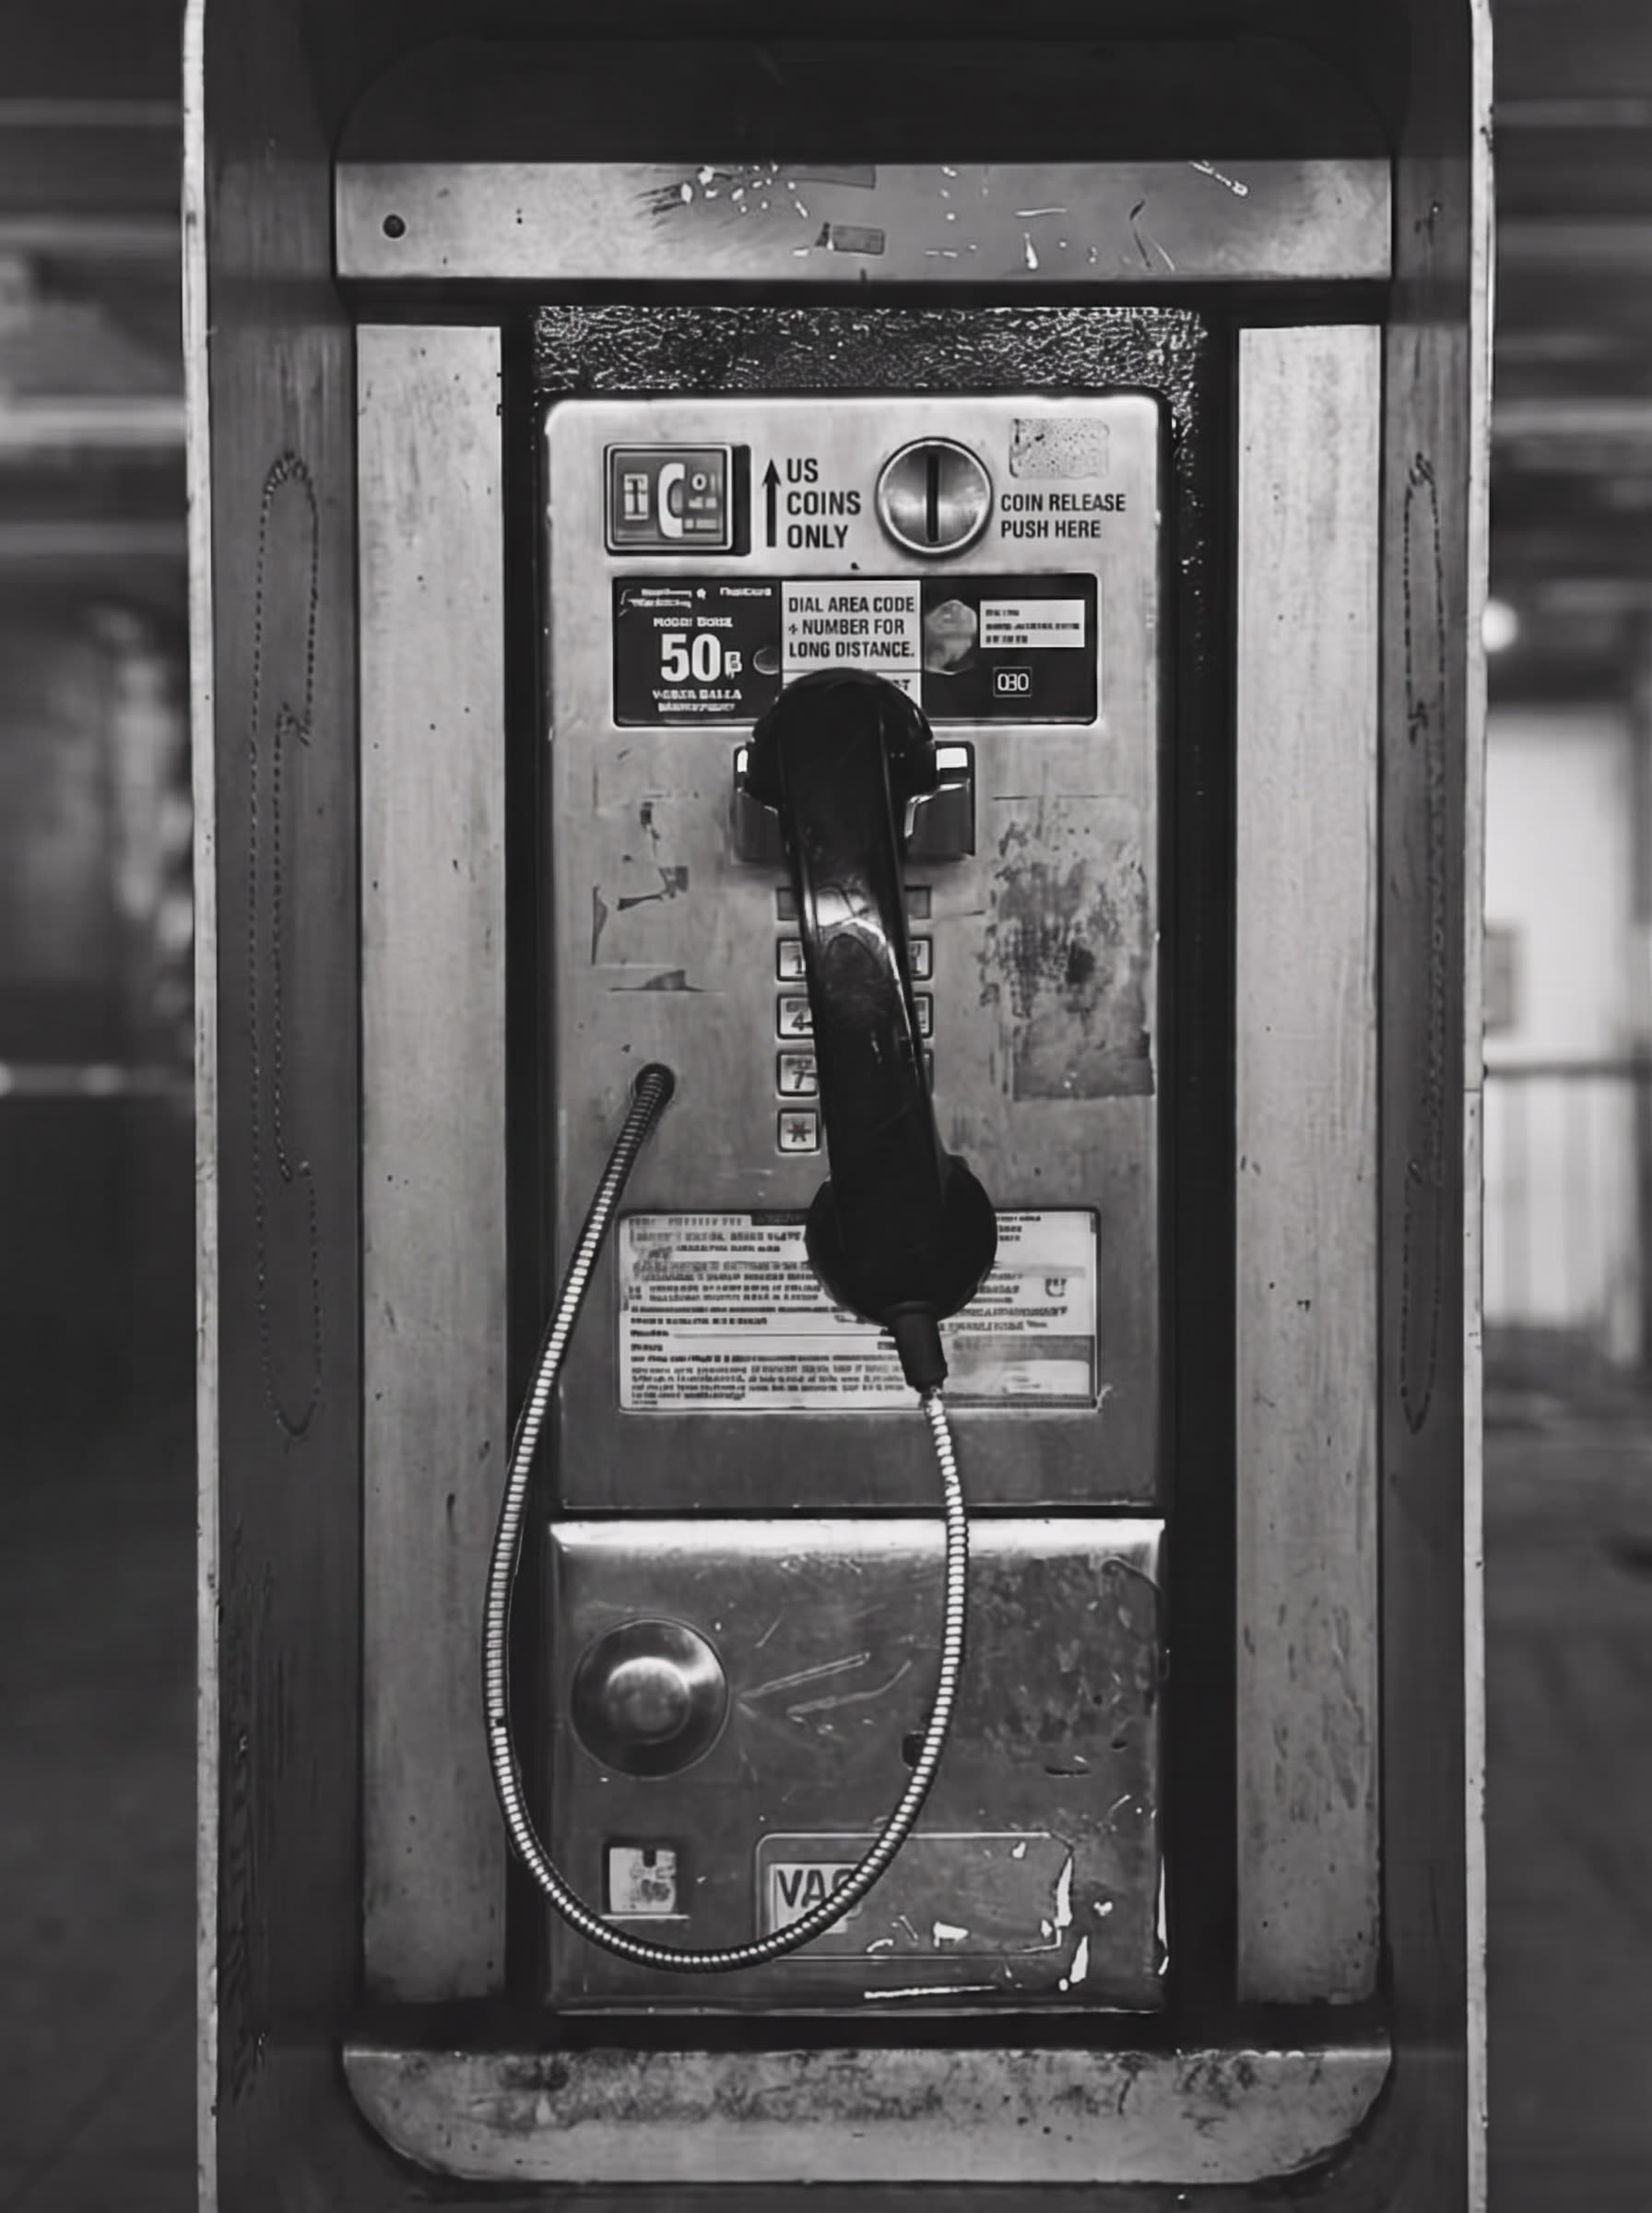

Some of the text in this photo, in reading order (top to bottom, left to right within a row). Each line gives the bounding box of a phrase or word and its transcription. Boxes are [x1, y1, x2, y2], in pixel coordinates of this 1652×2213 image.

[786, 457, 819, 484] US
[786, 490, 862, 516] COINS
[1000, 492, 1127, 513] COIN RELEASE
[786, 524, 849, 550] ONLY
[1000, 519, 1102, 539] PUSH HERE
[788, 597, 915, 613] DIAL AREA CODE
[802, 619, 869, 636] NUMBER
[874, 619, 905, 636] FOR
[788, 641, 915, 658] LONG DISTANCE.
[791, 1012, 806, 1032] 4
[791, 1070, 805, 1090] 7
